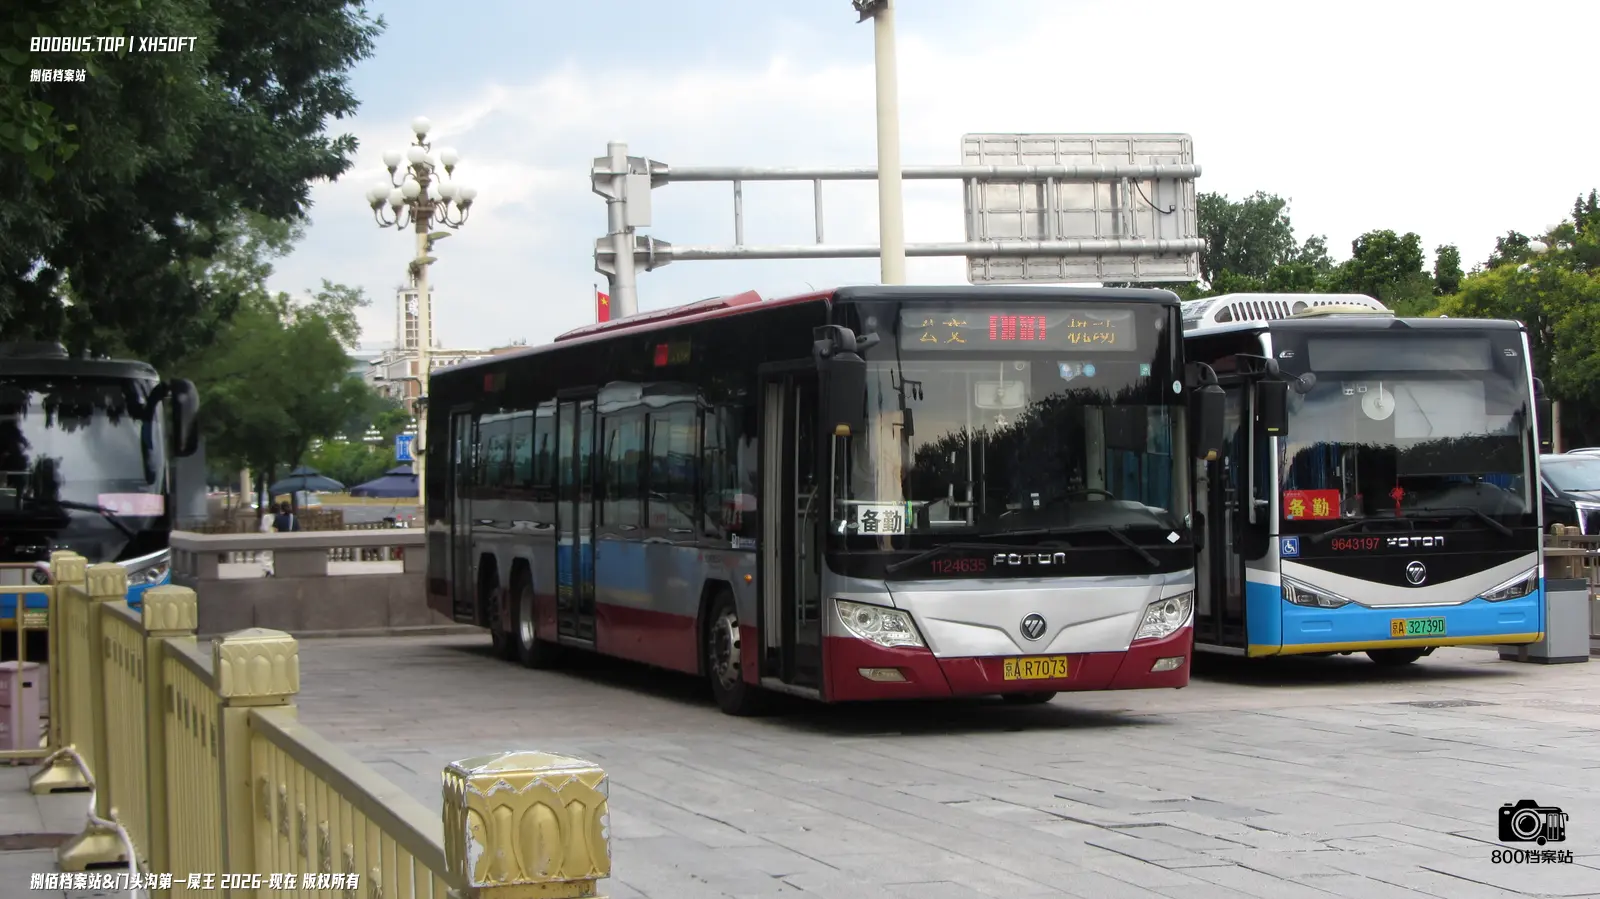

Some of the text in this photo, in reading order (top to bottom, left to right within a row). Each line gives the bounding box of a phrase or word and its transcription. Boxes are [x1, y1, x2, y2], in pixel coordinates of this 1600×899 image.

[1288, 497, 1330, 518] 备勤
[860, 508, 902, 533] 备勤
[1331, 537, 1380, 551] 9643197
[930, 558, 987, 574] 1124635
[992, 552, 1066, 566] FOTON
